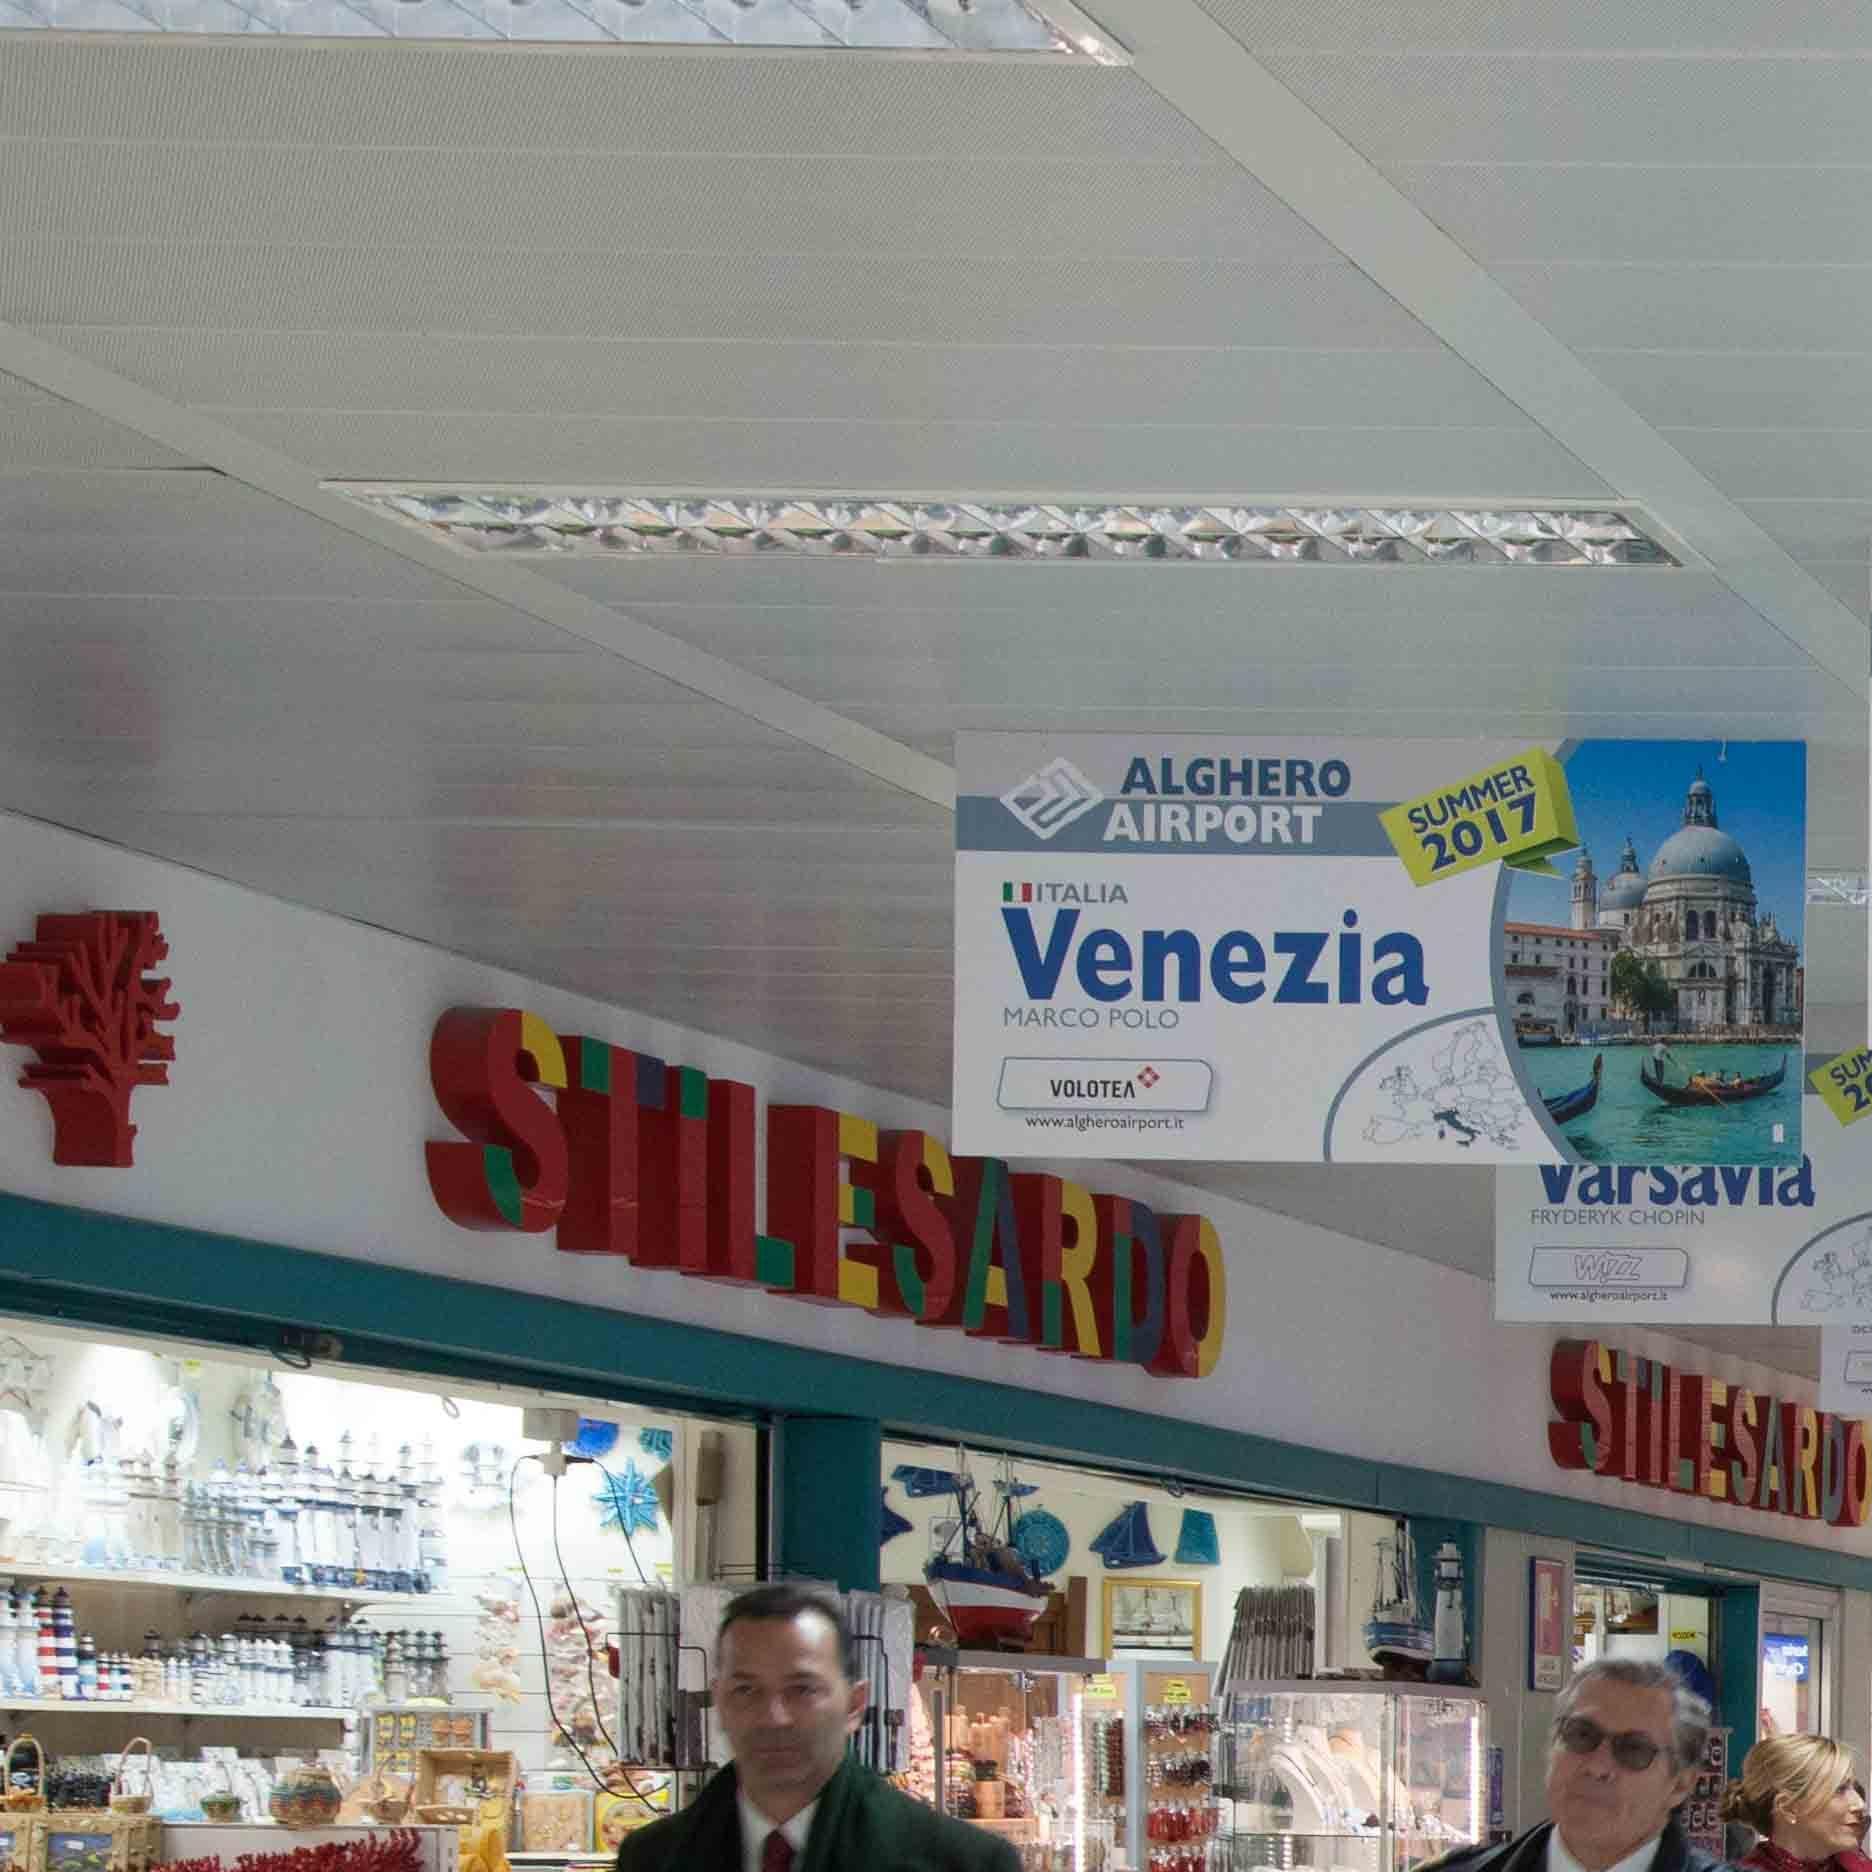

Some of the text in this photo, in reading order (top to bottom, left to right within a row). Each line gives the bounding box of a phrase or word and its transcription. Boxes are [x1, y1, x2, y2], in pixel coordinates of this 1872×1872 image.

[1121, 756, 1352, 798] ALGHERO
[1406, 764, 1534, 834] SUMMER
[1103, 805, 1322, 845] AIRPORT
[1419, 795, 1540, 874] 2017
[1036, 883, 1128, 905] ITALIA
[1001, 907, 1430, 1006] Venezia
[1003, 1008, 1179, 1028] MARCO POLO
[1050, 1079, 1136, 1099] VOLOTEA
[1025, 1112, 1185, 1133] www.algheroairport.it
[426, 1006, 1225, 1378] STILESARDO
[1538, 1155, 1816, 1207] Varsavia
[1530, 1209, 1705, 1225] FRYDERYK CHOPIN
[1548, 1339, 1872, 1526] STILESARDO
